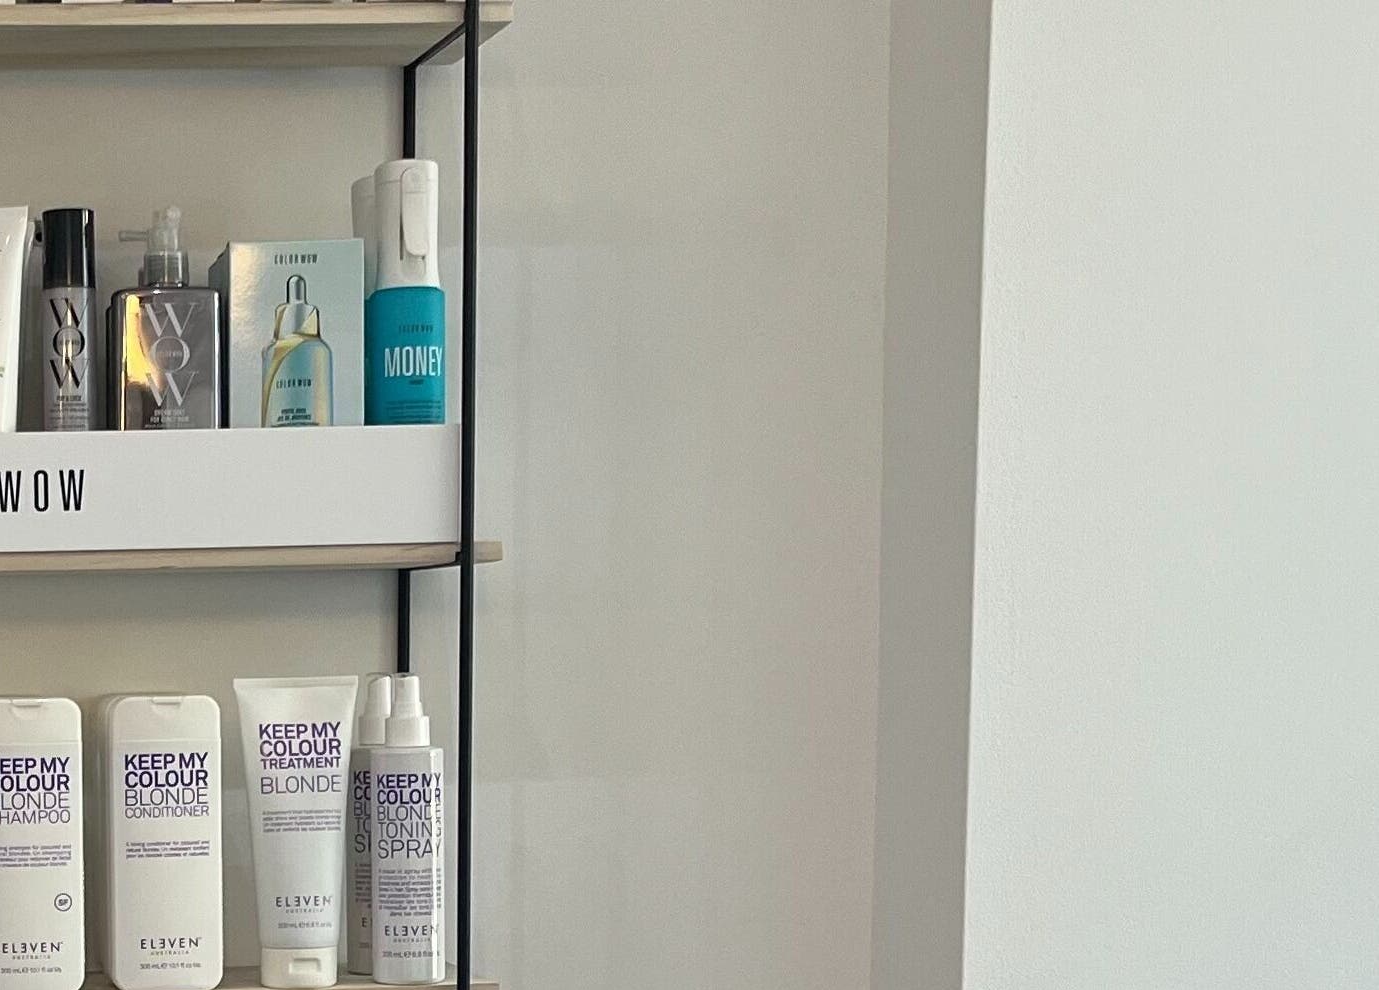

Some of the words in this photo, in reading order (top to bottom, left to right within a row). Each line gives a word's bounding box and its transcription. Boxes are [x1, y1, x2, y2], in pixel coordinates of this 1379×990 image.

[384, 345, 443, 378] MONEY
[259, 723, 308, 739] KEEP
[311, 721, 341, 739] MY
[260, 738, 342, 756] COLOUR
[40, 757, 70, 774] MY
[124, 753, 175, 771] KEEP
[179, 752, 208, 769] MY
[260, 756, 341, 770] TREATMENT
[124, 770, 208, 788] COLOUR
[260, 774, 342, 795] BLONDE
[353, 771, 371, 785] KE
[376, 774, 419, 789] KEEP
[421, 772, 441, 788] MY
[125, 787, 208, 806] BLONDE
[376, 788, 441, 805] COLOUR
[125, 805, 209, 819] CONDITIONER
[275, 895, 331, 908] ELEVEN
[2, 942, 61, 954] ELEVEN
[140, 937, 199, 950] ELEVEN
